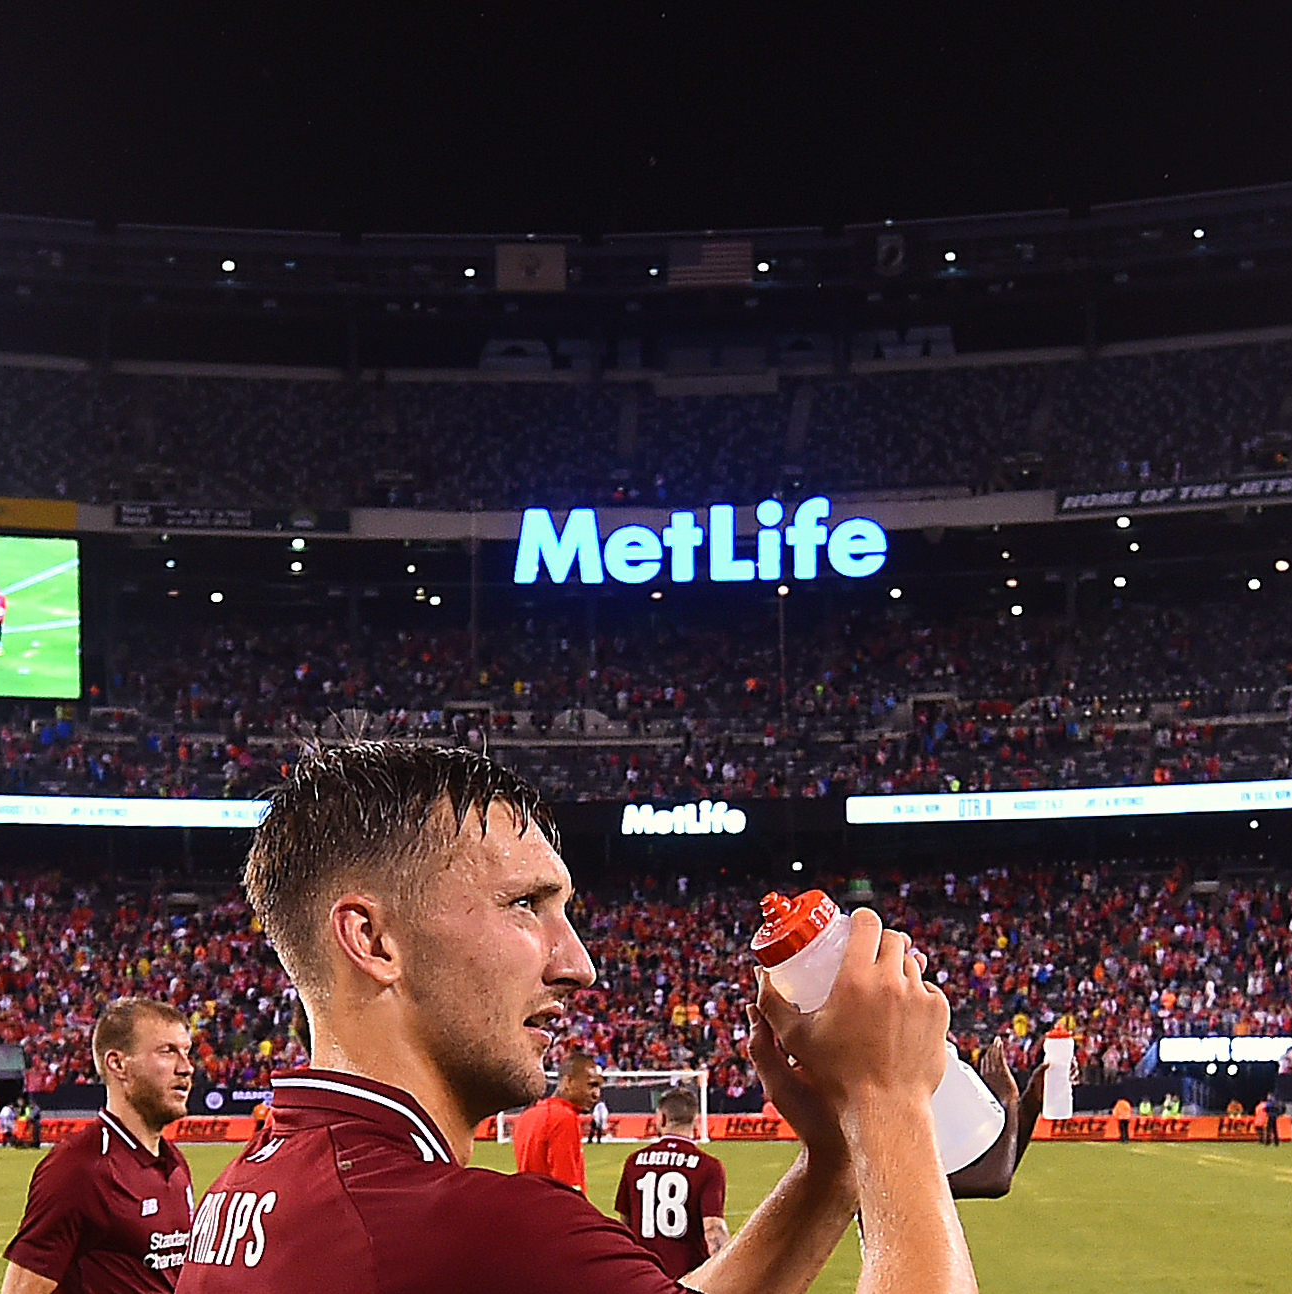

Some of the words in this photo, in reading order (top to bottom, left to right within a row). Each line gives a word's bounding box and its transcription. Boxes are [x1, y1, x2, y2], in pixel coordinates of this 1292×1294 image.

[513, 496, 888, 584] MetLife
[621, 799, 747, 835] MetLife
[175, 1119, 229, 1136] Hertz
[726, 1117, 781, 1134] Hertz
[1052, 1118, 1105, 1134] Hertz
[1135, 1118, 1191, 1134] Hertz
[636, 1171, 689, 1239] 18
